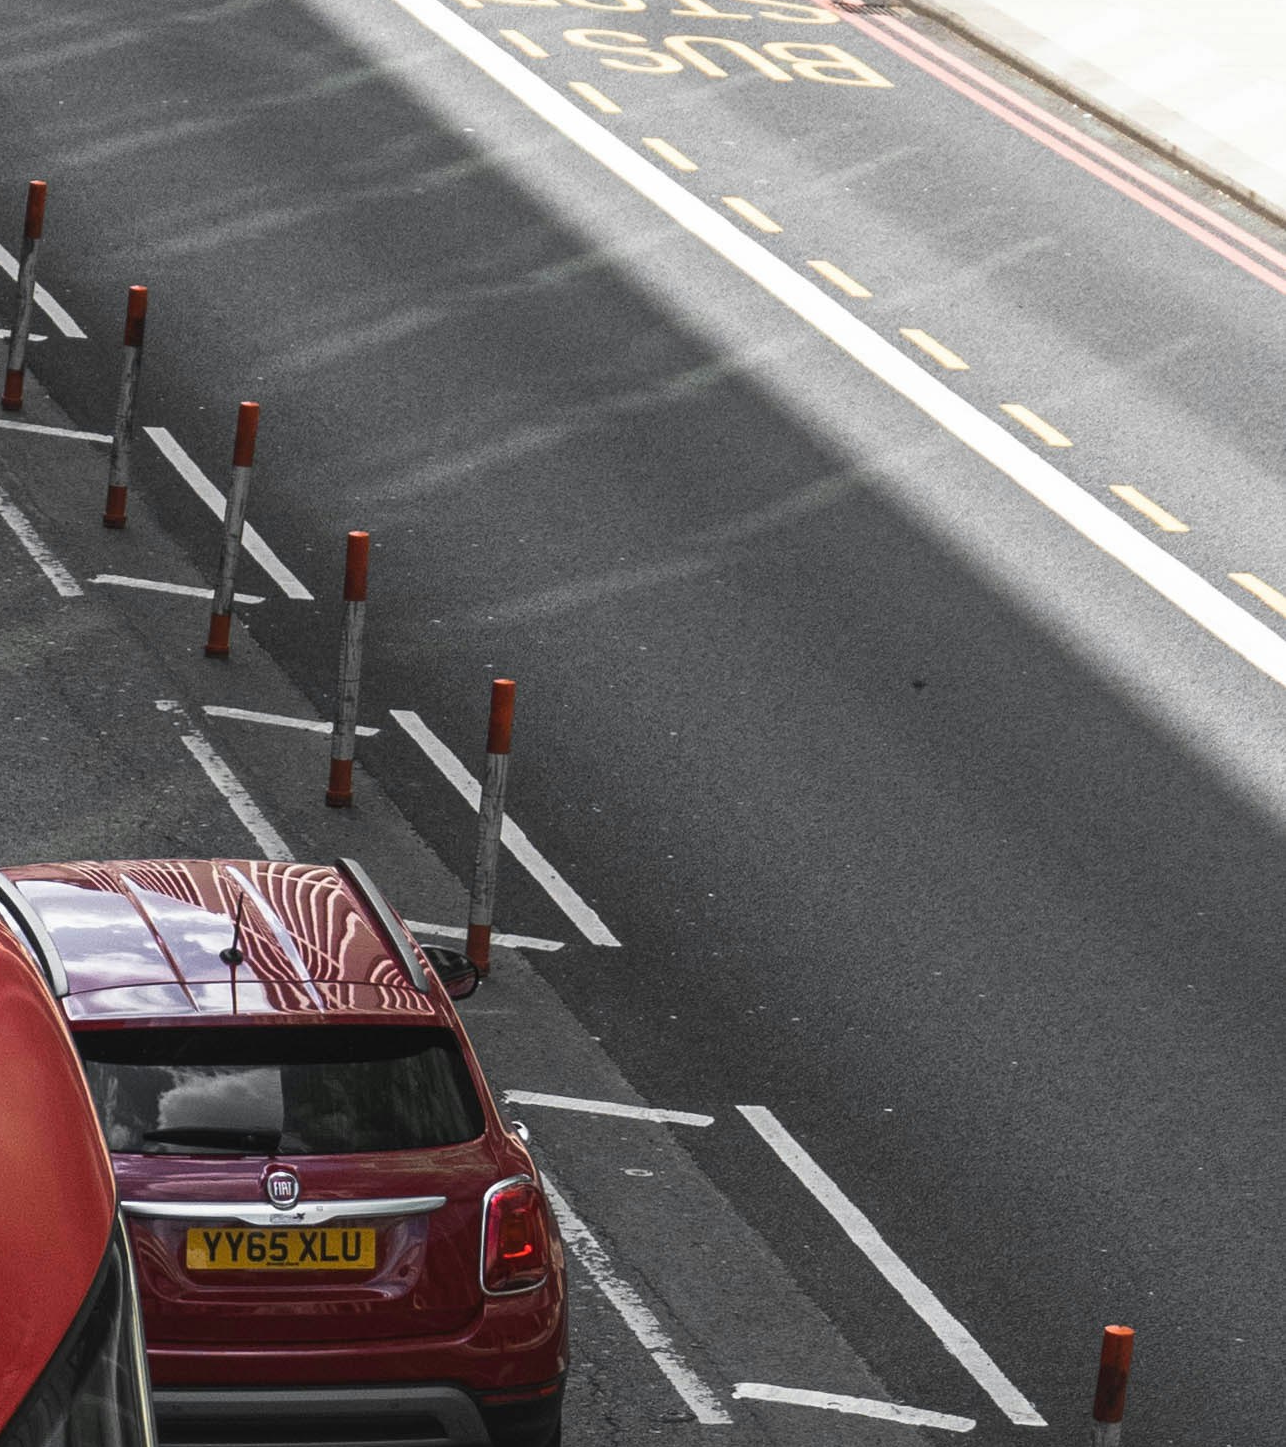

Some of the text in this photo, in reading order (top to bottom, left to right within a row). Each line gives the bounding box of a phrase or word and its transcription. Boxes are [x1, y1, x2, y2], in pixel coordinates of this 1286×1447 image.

[566, 28, 894, 88] BUS
[273, 1180, 292, 1196] FIAT
[203, 1230, 361, 1264] YY65 XLU
